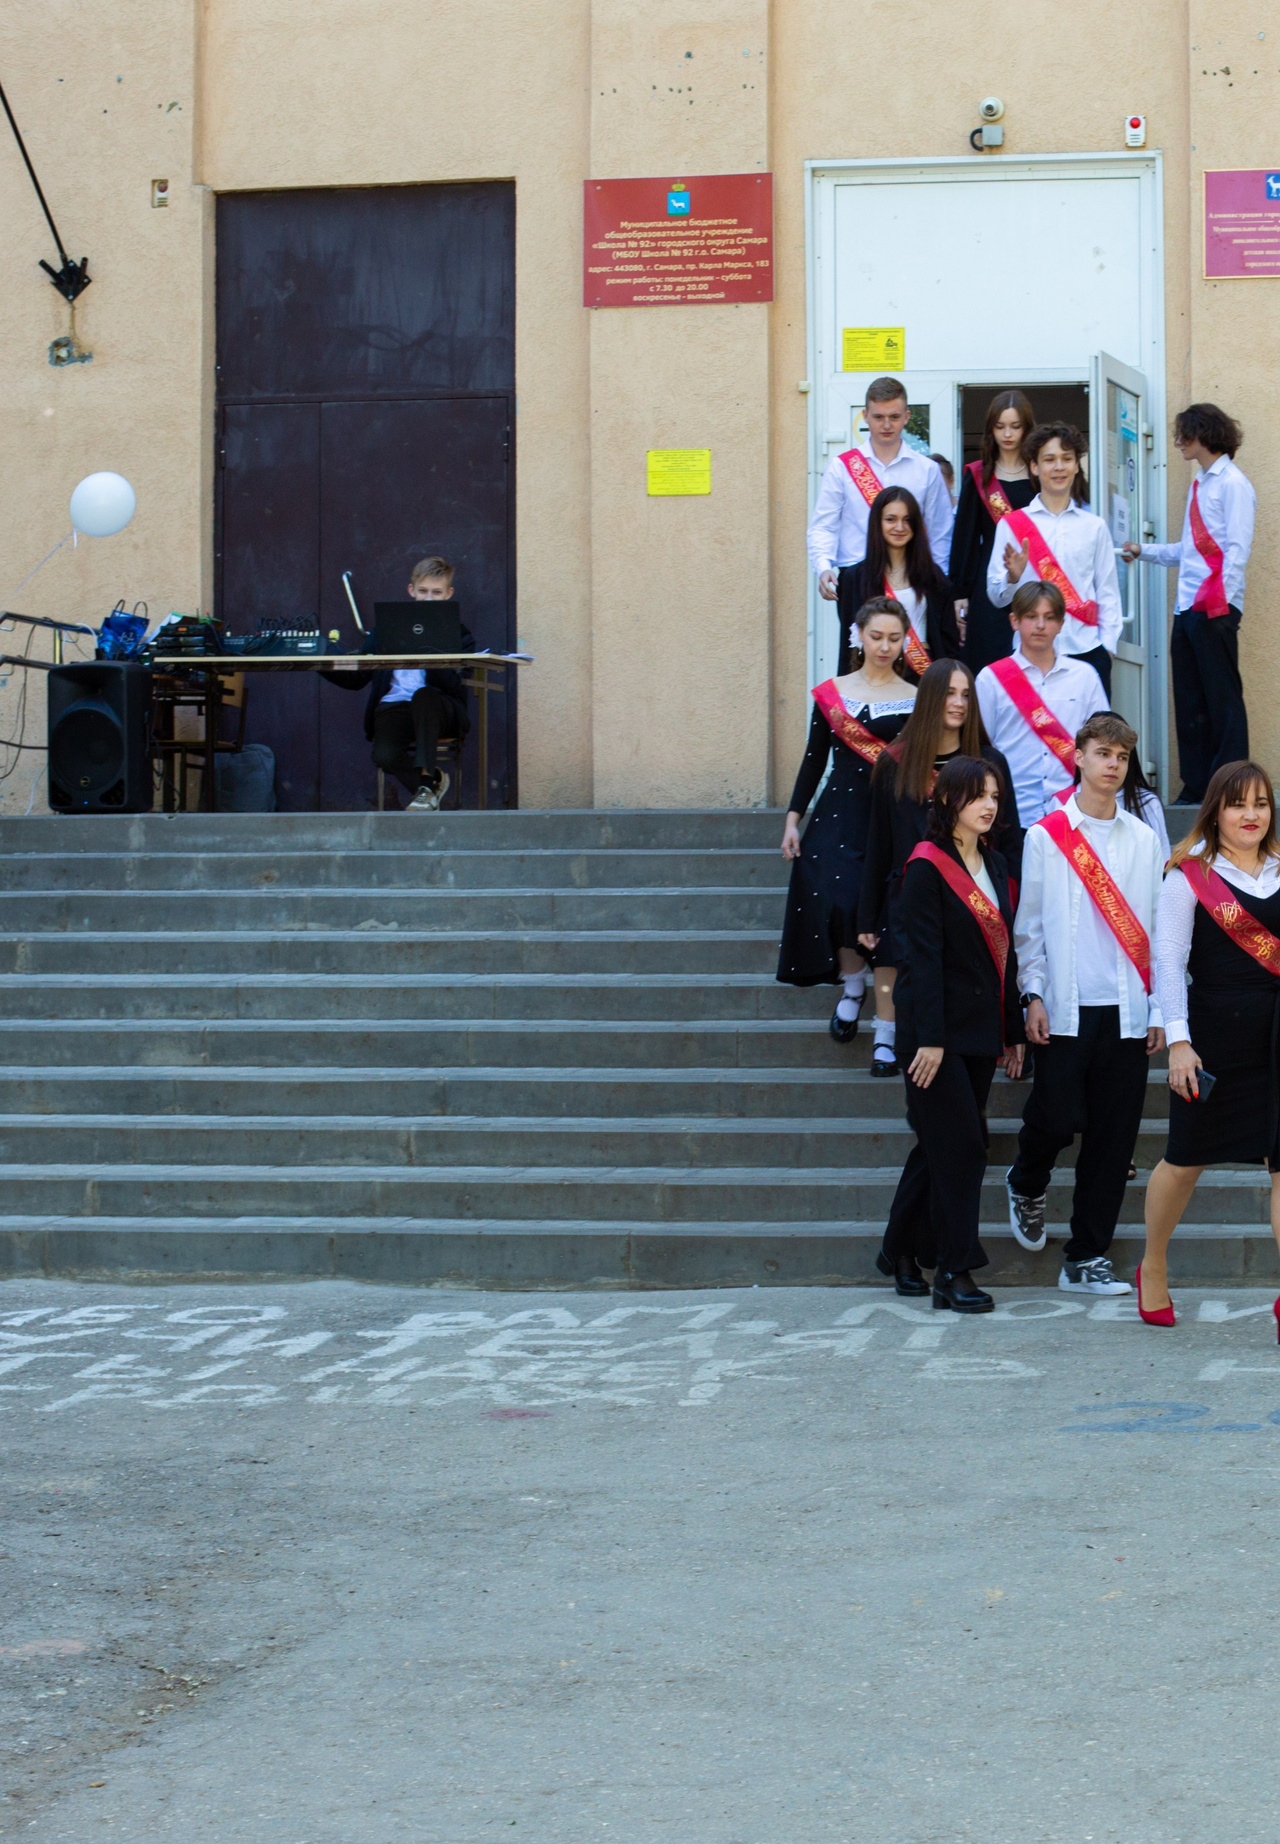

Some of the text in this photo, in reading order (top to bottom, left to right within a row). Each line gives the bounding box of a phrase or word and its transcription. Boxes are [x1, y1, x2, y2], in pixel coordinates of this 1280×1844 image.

[620, 218, 738, 230] Муниципальное бюджетное
[604, 228, 753, 239] общеобразовательное учреждение
[592, 236, 768, 249] «Школа № 92» городского округа Самара
[612, 250, 640, 260] (МБОУ
[641, 250, 670, 258] Школа
[682, 248, 694, 256] 92
[710, 246, 746, 256] Самара)
[698, 262, 722, 270] Карла
[723, 262, 754, 270] Маркса,
[606, 278, 632, 286] режим
[632, 276, 664, 285] работы:
[720, 273, 752, 282] суббота
[656, 284, 673, 292] 7.30
[687, 292, 726, 300] выходной
[1087, 865, 1141, 946] Выпускник
[390, 1302, 781, 1335] ВАМ,
